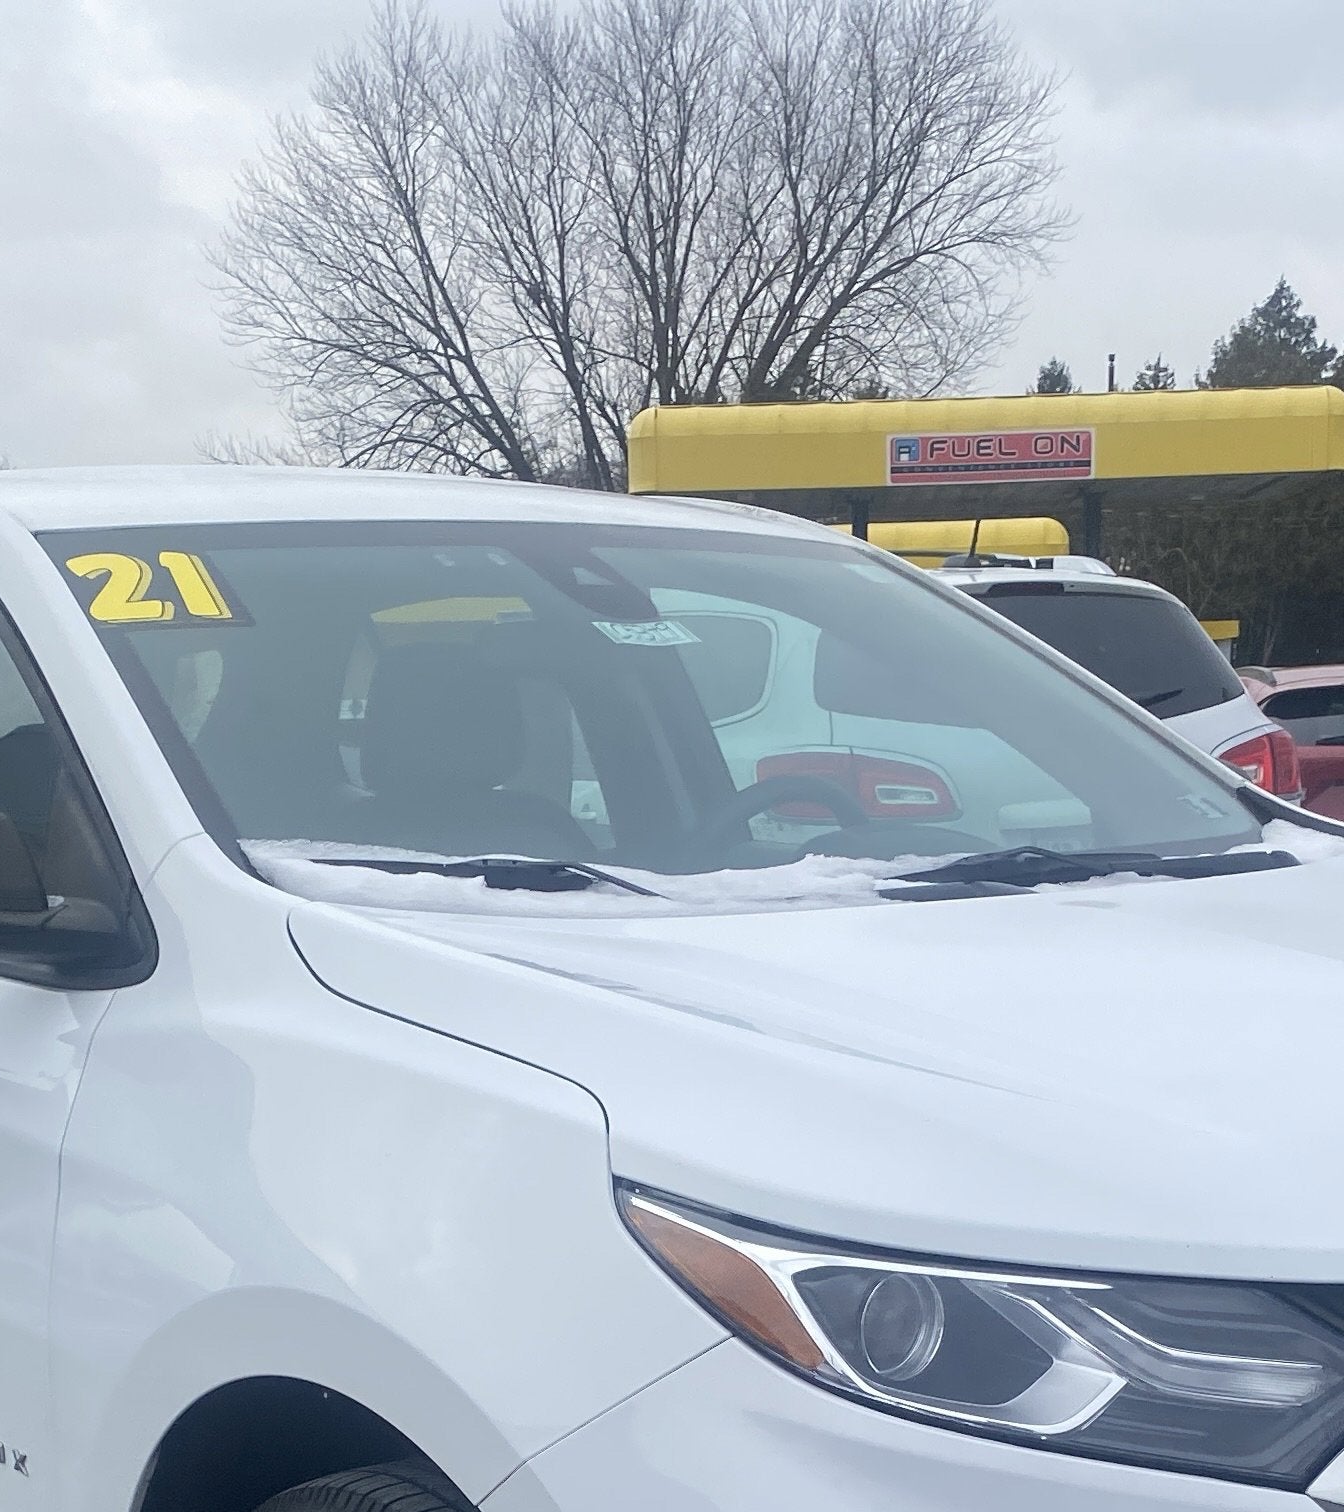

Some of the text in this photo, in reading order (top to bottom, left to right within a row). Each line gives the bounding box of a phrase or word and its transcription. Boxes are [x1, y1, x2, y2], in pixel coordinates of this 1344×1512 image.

[929, 435, 1081, 458] FUEL ON
[65, 551, 233, 623] 21
